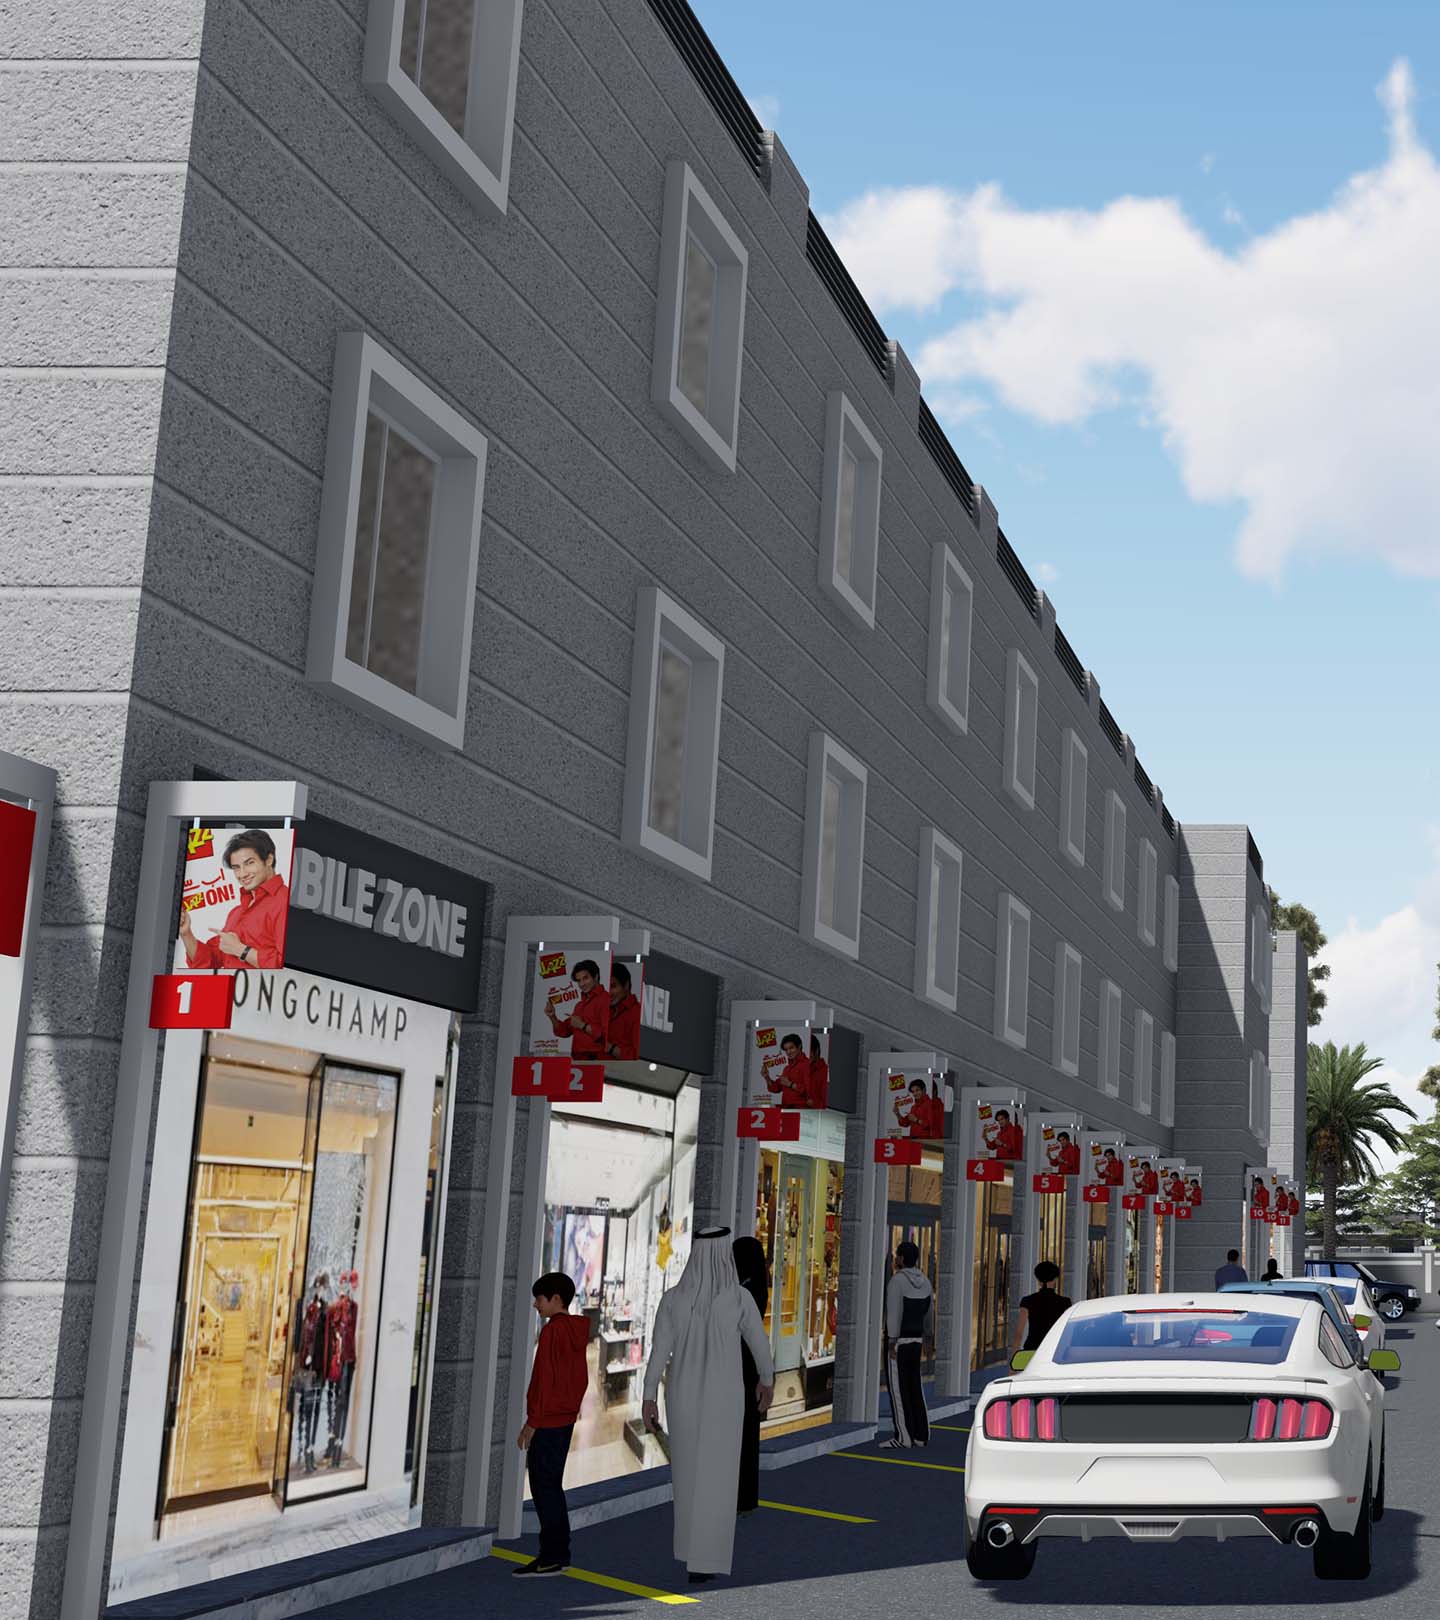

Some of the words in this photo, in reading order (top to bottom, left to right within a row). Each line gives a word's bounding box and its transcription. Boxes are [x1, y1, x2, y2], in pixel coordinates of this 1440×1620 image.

[206, 884, 235, 906] ON!
[374, 878, 467, 958] ZONE
[176, 980, 193, 1014] 1
[232, 968, 408, 1042] ONGCHAMP
[531, 1061, 543, 1086] 1
[569, 1068, 583, 1091] 2
[750, 1110, 765, 1129] 2
[883, 1142, 895, 1158] 3
[973, 1162, 984, 1175] 4
[1041, 1177, 1049, 1189] 5
[1089, 1188, 1098, 1198] 6
[1129, 1197, 1136, 1206] 7
[1160, 1203, 1166, 1211] 8
[1254, 1209, 1264, 1217] 10
